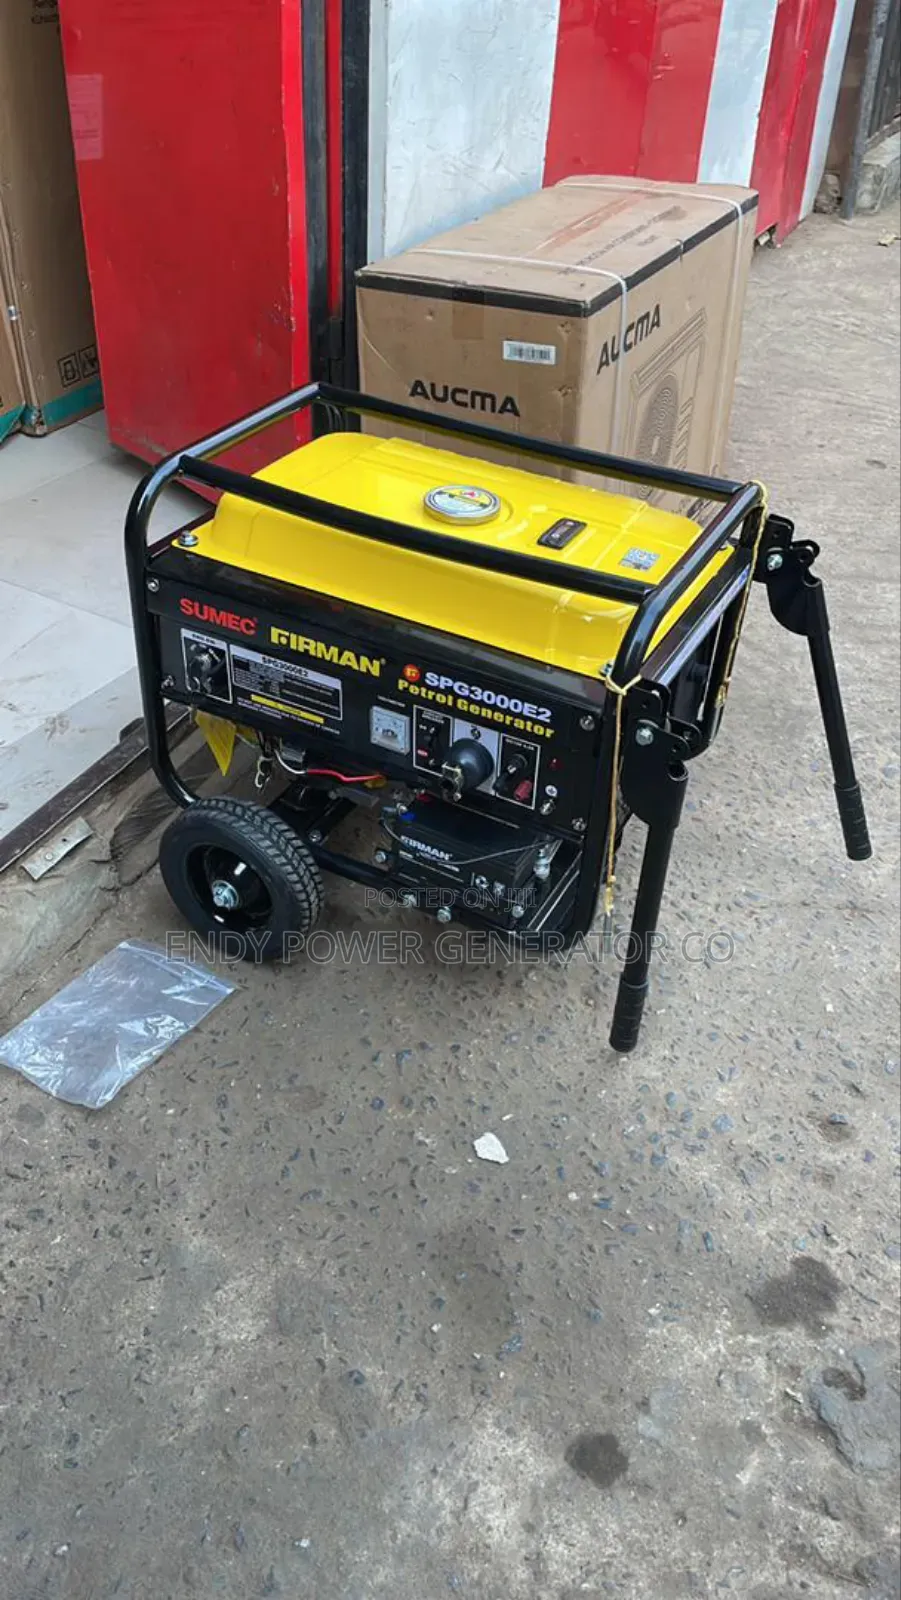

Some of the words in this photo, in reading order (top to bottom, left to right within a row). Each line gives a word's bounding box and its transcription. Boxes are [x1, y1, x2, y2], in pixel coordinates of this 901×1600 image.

[596, 303, 662, 376] AUCMA
[408, 379, 521, 418] AUCMA
[179, 598, 256, 635] SUMEC
[270, 626, 381, 677] FIRMAN
[397, 678, 453, 707] Petrol
[456, 697, 556, 739] Generator
[424, 671, 552, 723] SPG3000E2
